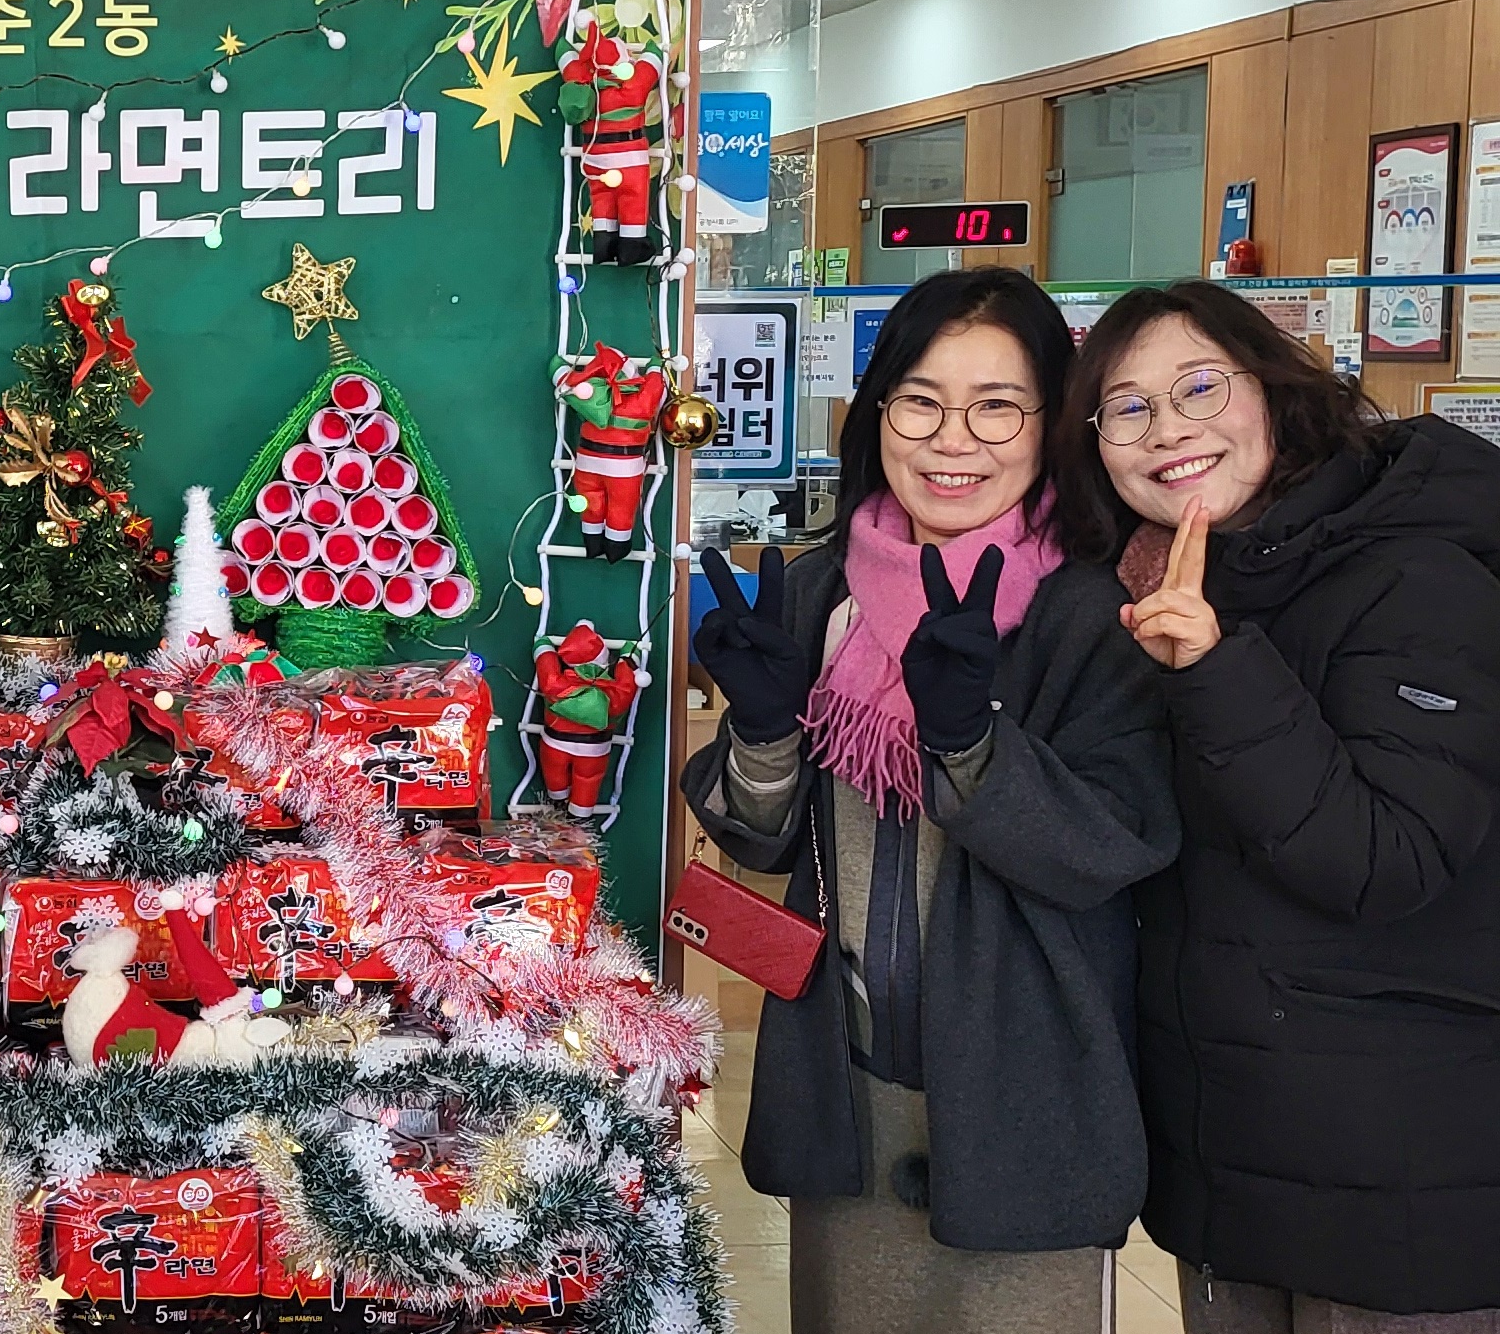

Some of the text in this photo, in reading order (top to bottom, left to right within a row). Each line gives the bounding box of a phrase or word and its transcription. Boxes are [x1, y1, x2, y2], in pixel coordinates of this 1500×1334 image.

[5, 108, 438, 239] 라면트리
[955, 210, 990, 241] 10
[361, 725, 436, 818] 辛
[258, 886, 336, 994] 辛
[91, 1205, 217, 1314] 辛 라면
[156, 1305, 188, 1323] 5개입
[363, 1304, 397, 1324] 5개입
